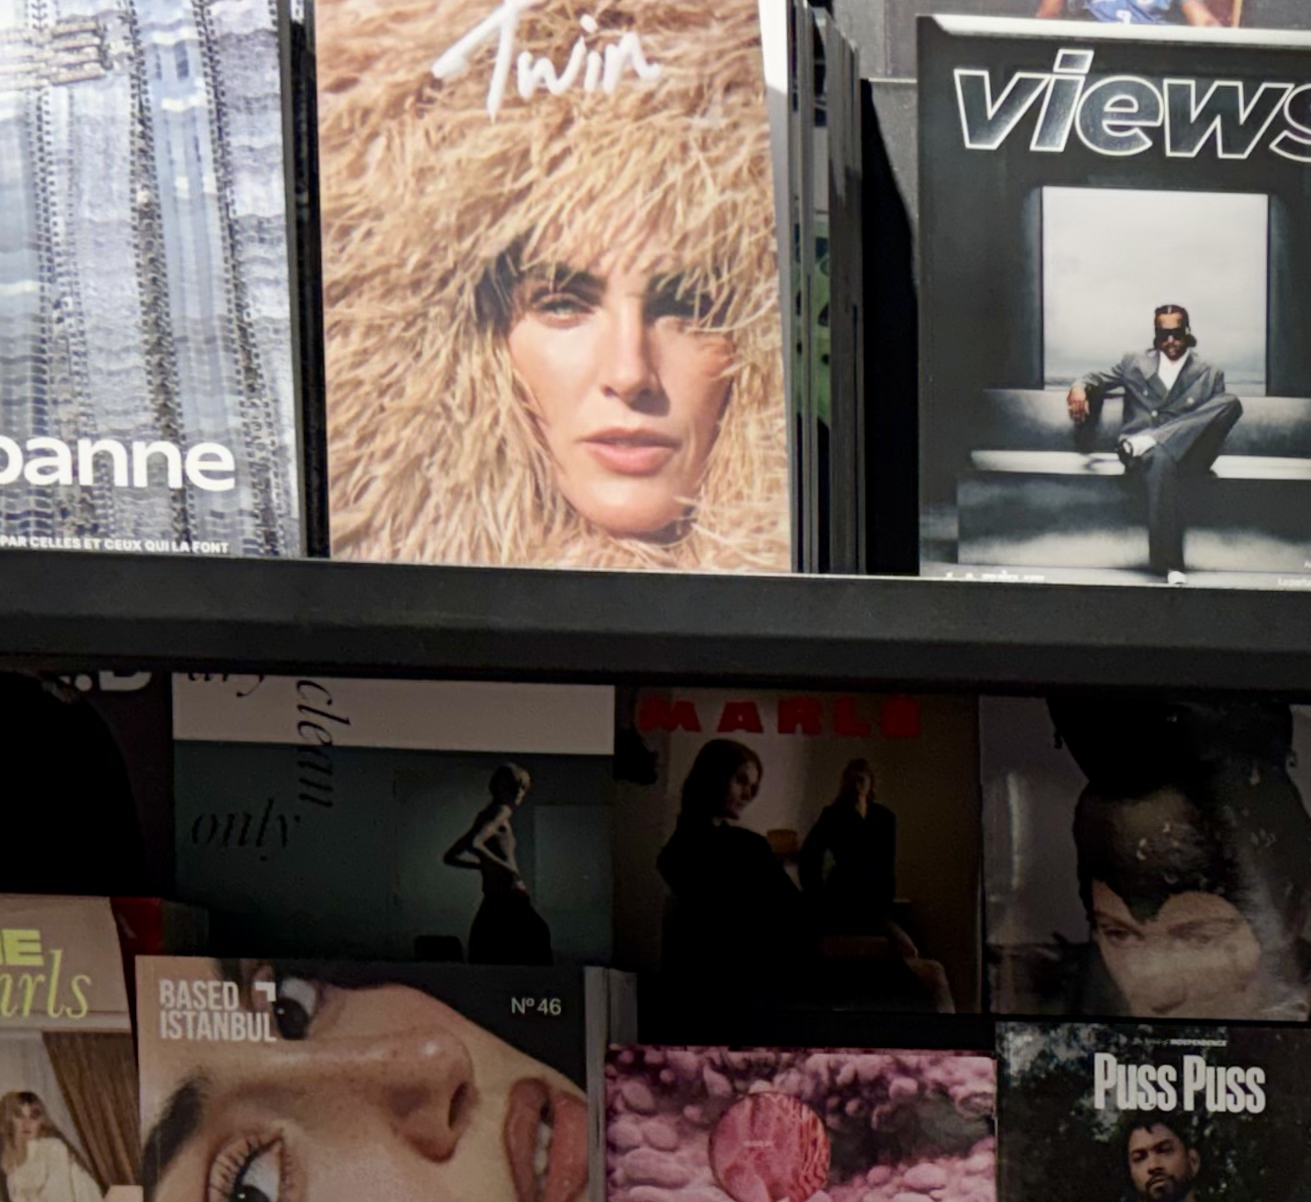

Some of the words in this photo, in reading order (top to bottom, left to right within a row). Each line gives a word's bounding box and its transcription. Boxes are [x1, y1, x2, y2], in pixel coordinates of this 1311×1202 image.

[433, 0, 662, 121] Twin
[29, 538, 81, 550] CELLES
[84, 539, 102, 550] ET
[104, 540, 143, 551] CEUX
[145, 541, 170, 553] QUI
[172, 541, 191, 553] LA
[194, 542, 229, 554] FONT
[159, 978, 240, 1010] BASED
[159, 1010, 278, 1043] ISTANBUL
[1093, 1052, 1178, 1112] Puss
[1183, 1054, 1266, 1114] Puss
